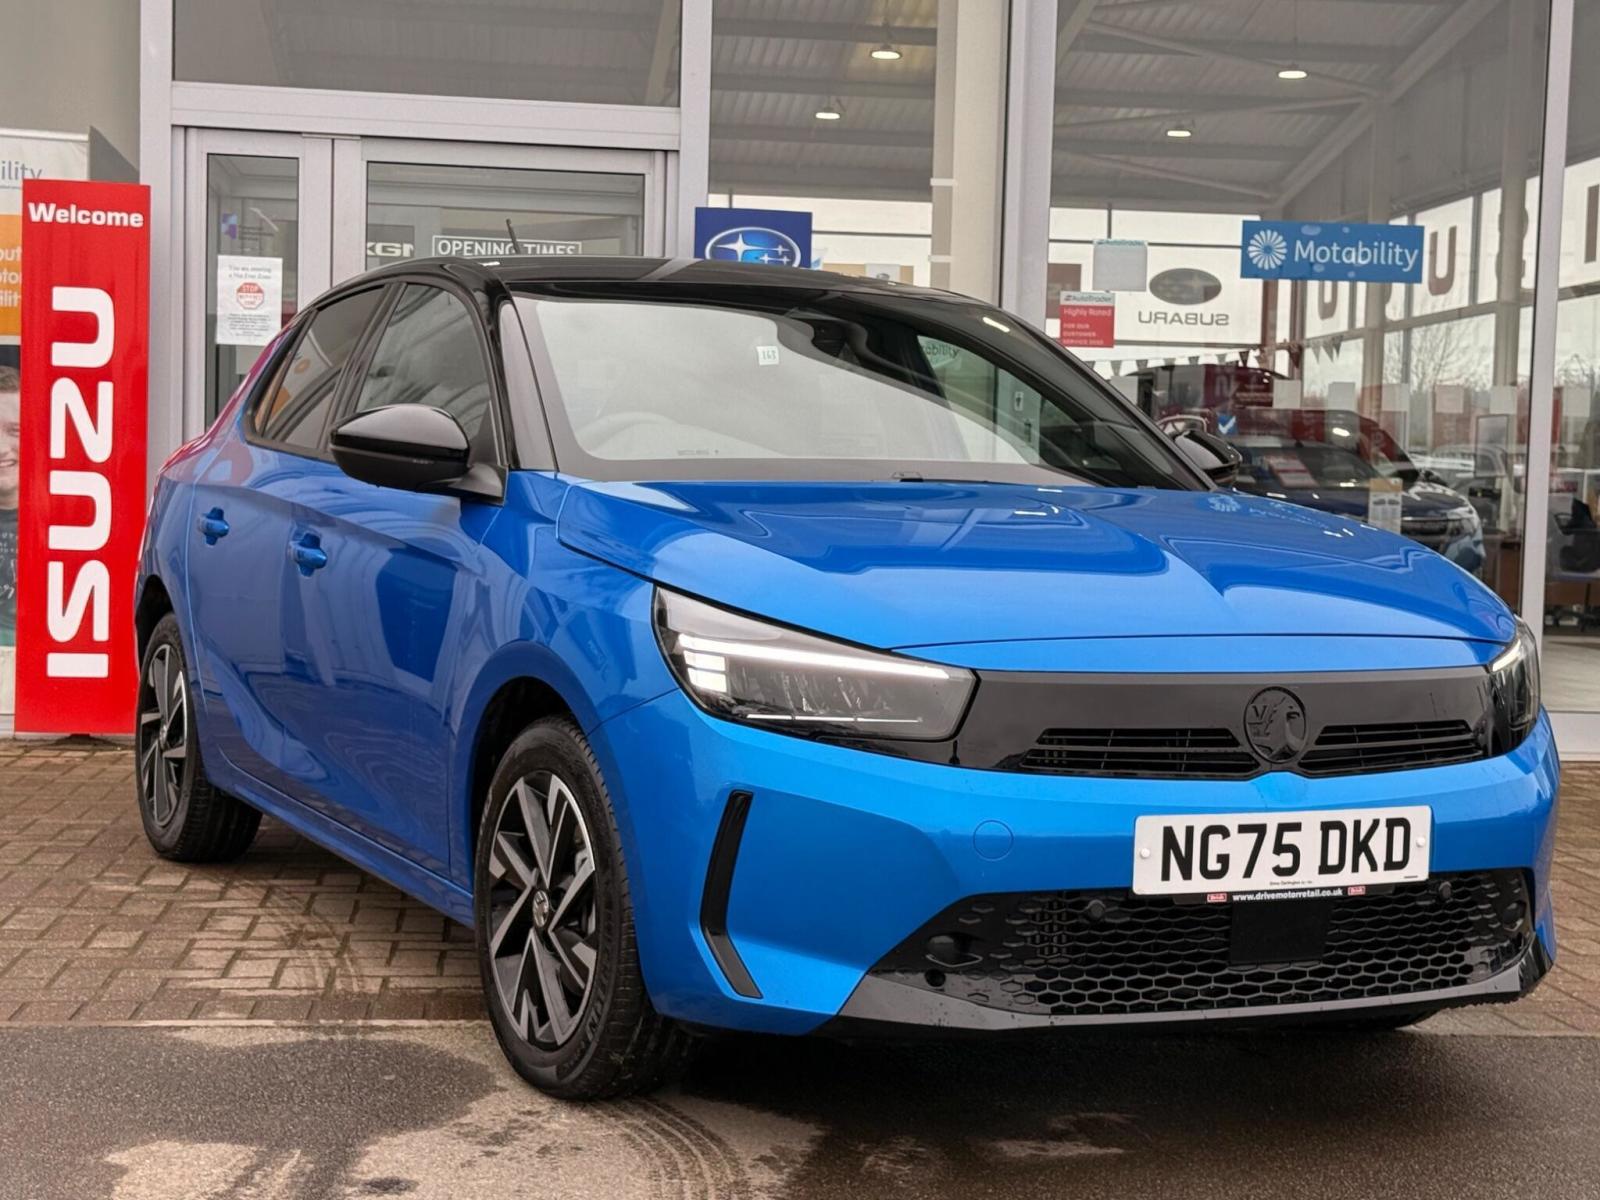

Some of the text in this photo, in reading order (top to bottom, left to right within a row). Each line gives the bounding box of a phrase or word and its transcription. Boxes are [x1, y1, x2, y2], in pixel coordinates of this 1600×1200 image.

[0, 160, 43, 180] ility
[28, 202, 144, 228] Welcome
[438, 239, 577, 257] OPENING TIMES
[1294, 239, 1419, 273] Motability
[46, 285, 115, 678] ISUZU
[1160, 816, 1412, 882] NG75 DKD
[1232, 888, 1344, 901] www.drivemotorretail.co.uk
